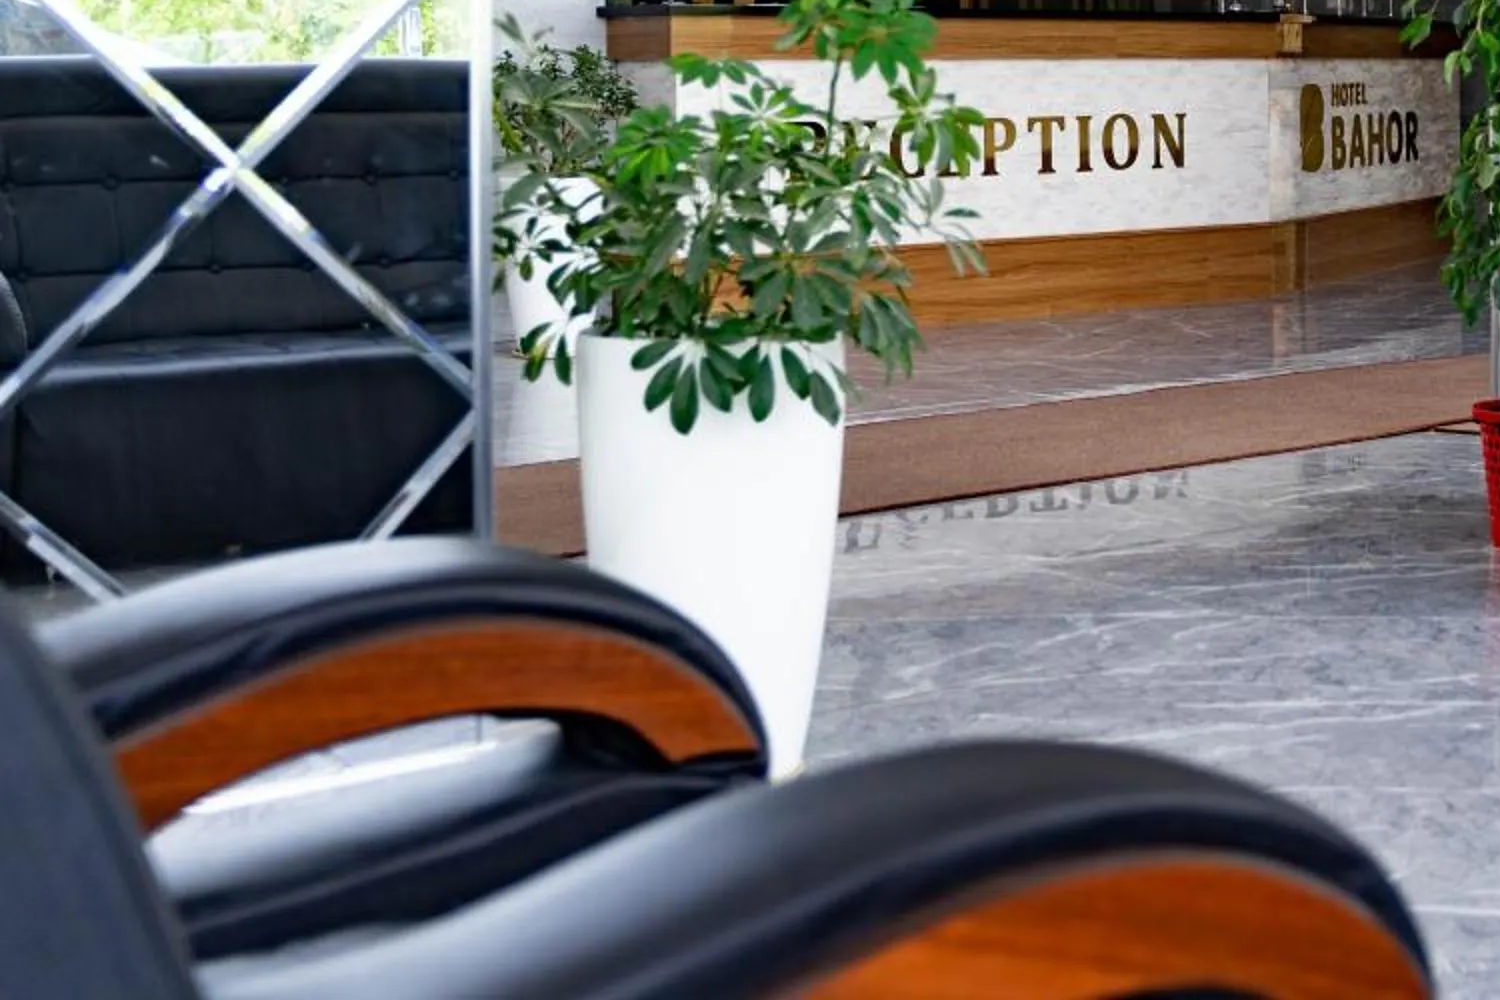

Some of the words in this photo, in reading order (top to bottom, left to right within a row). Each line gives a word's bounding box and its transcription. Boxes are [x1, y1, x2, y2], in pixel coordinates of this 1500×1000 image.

[1331, 82, 1368, 107] HOTEL
[786, 112, 1187, 183] ECPTION
[1331, 109, 1419, 171] BAHOR
